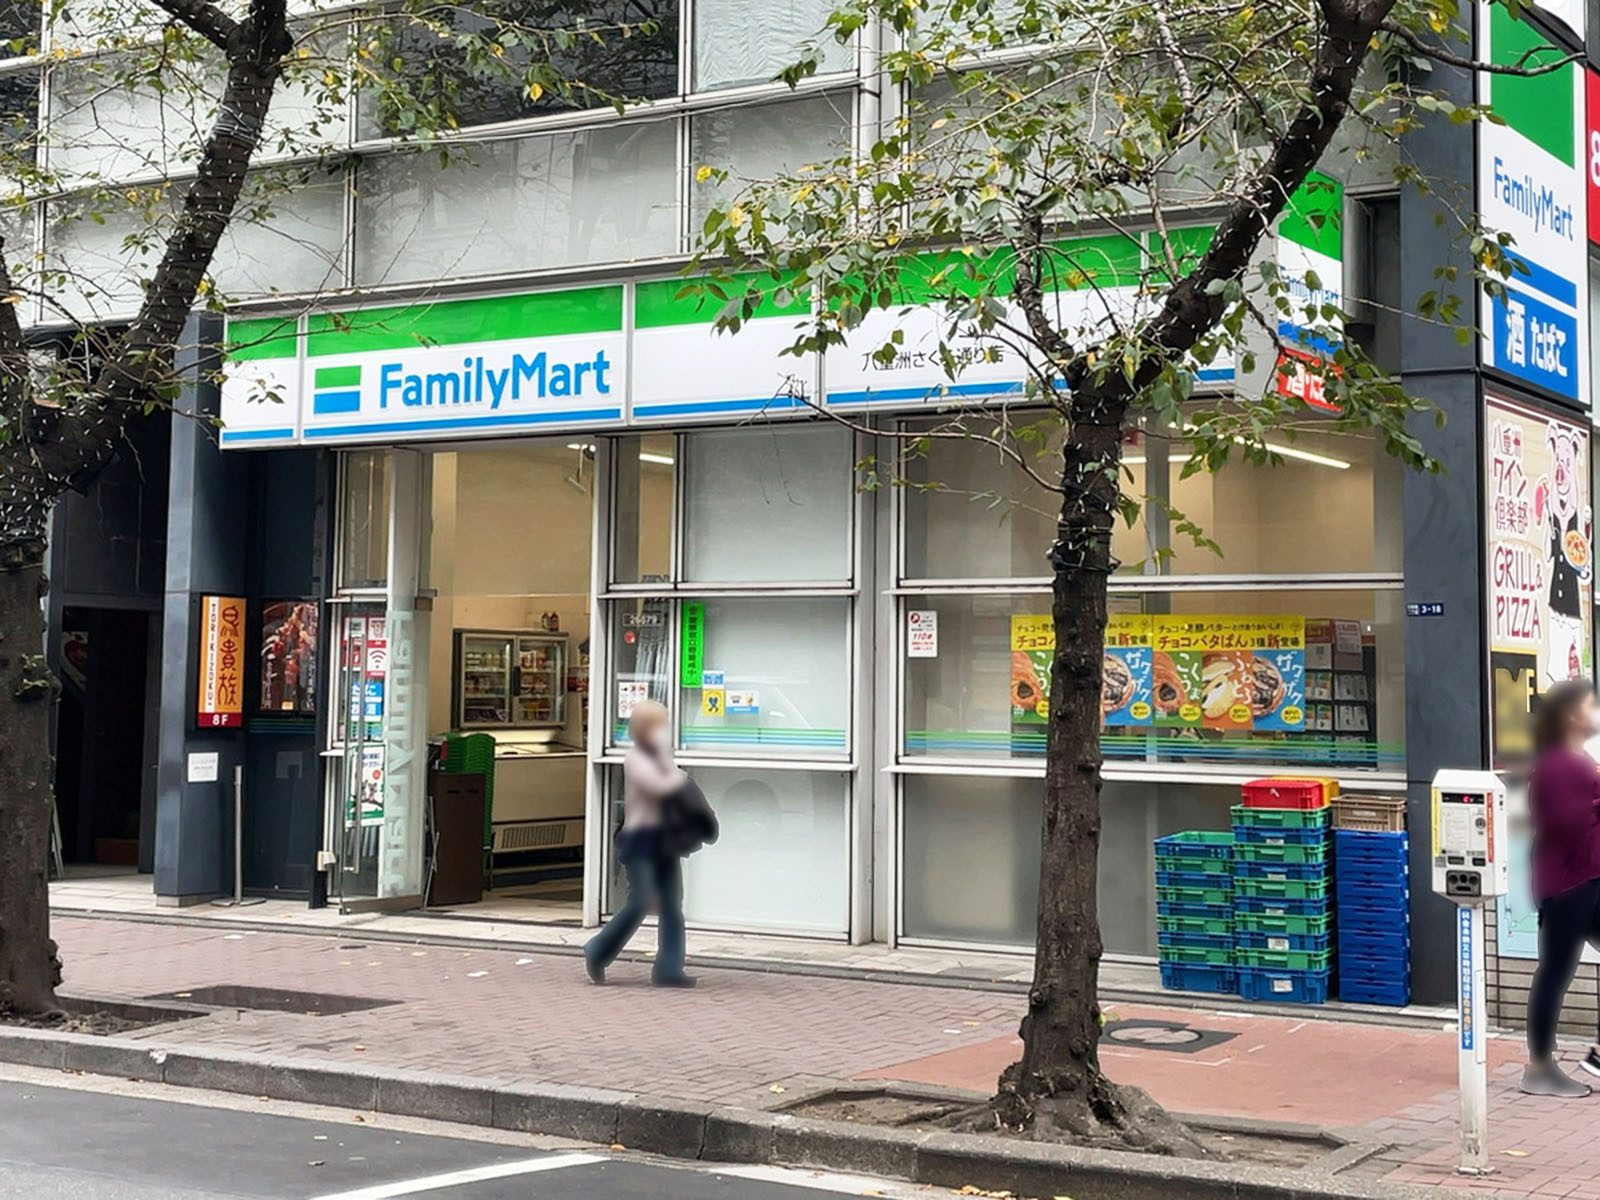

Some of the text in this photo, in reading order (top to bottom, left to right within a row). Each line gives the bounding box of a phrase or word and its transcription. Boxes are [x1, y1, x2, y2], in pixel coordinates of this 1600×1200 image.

[1494, 156, 1574, 241] FamilyMart
[1506, 299, 1567, 377] 酒 たばこ
[380, 350, 611, 409] FamilyMart
[1494, 457, 1527, 498] ワイン
[1496, 596, 1542, 639] PIZZA
[217, 604, 241, 706] 鳥貴族
[212, 714, 229, 726] 8F
